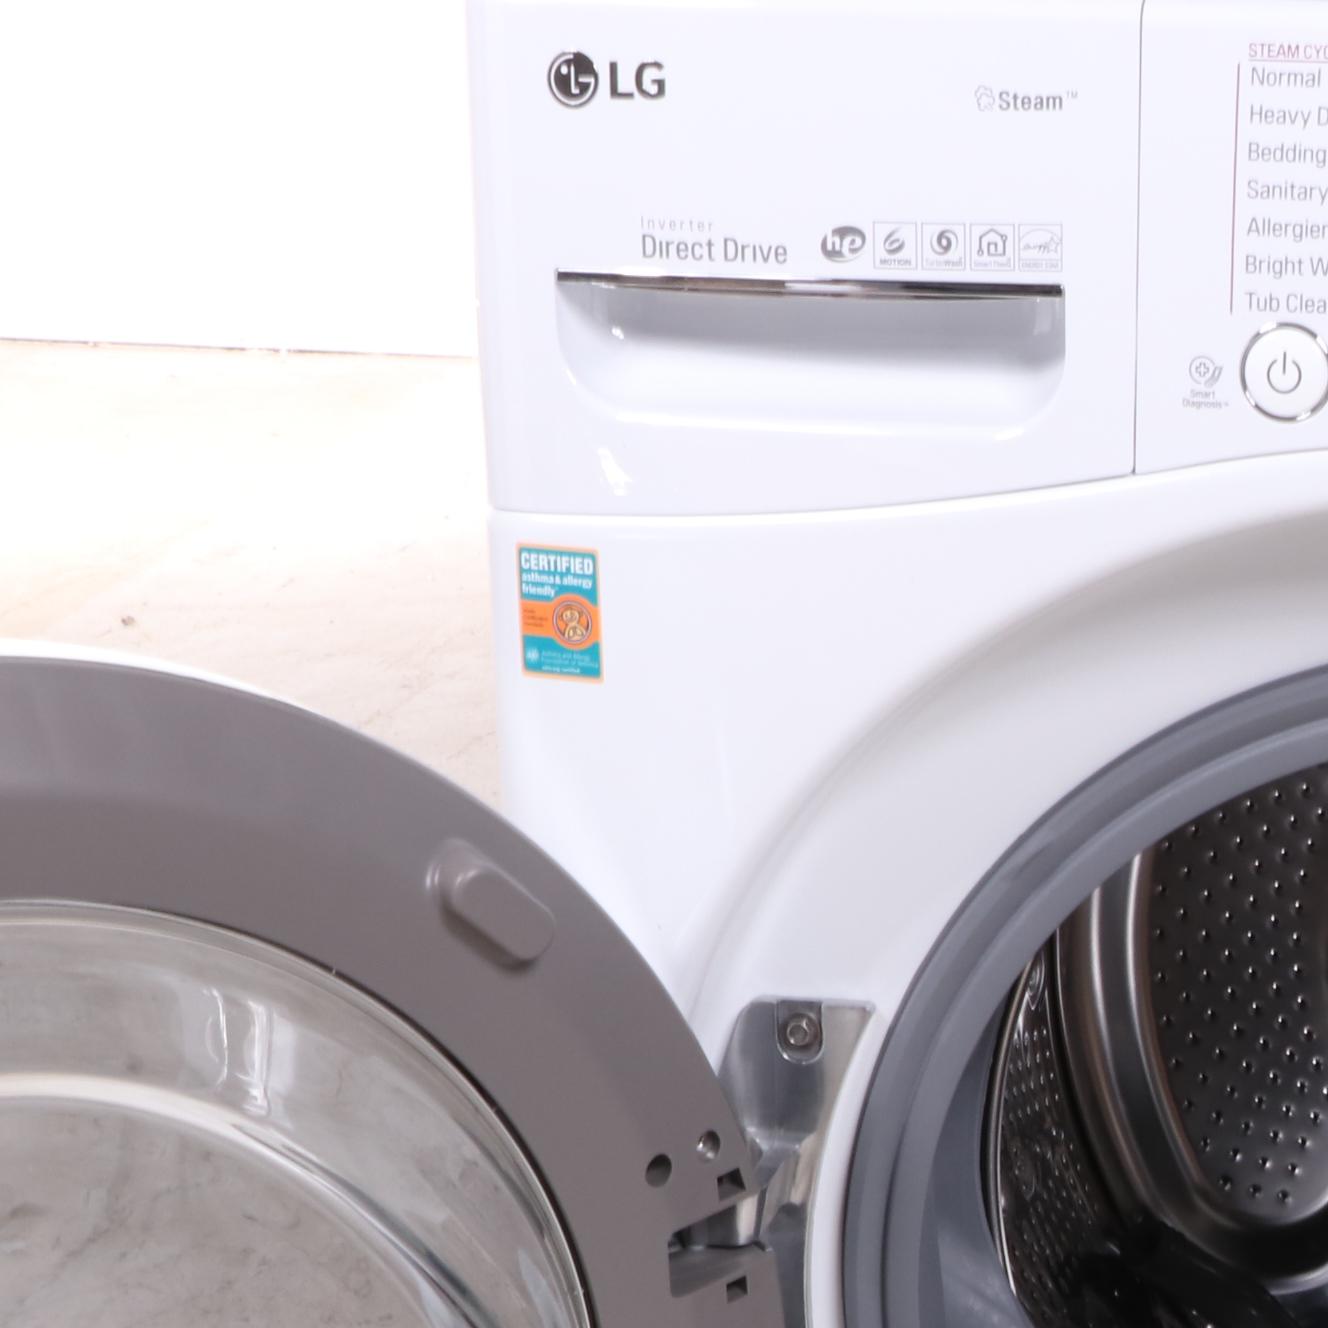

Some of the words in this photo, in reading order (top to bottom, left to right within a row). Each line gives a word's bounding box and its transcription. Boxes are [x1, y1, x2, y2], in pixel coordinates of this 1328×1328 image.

[1249, 43, 1300, 59] STEAM
[609, 61, 666, 99] LG
[1251, 66, 1321, 88] Normal
[1250, 104, 1311, 130] Heavy
[1248, 142, 1327, 168] Bedding
[1247, 179, 1328, 206] Sanitary
[640, 216, 713, 232] Inverter
[642, 234, 715, 261] Direct
[723, 237, 788, 264] Drive
[1245, 254, 1303, 280] Bright
[1245, 292, 1280, 312] Tub
[521, 551, 593, 576] CERTIFIED
